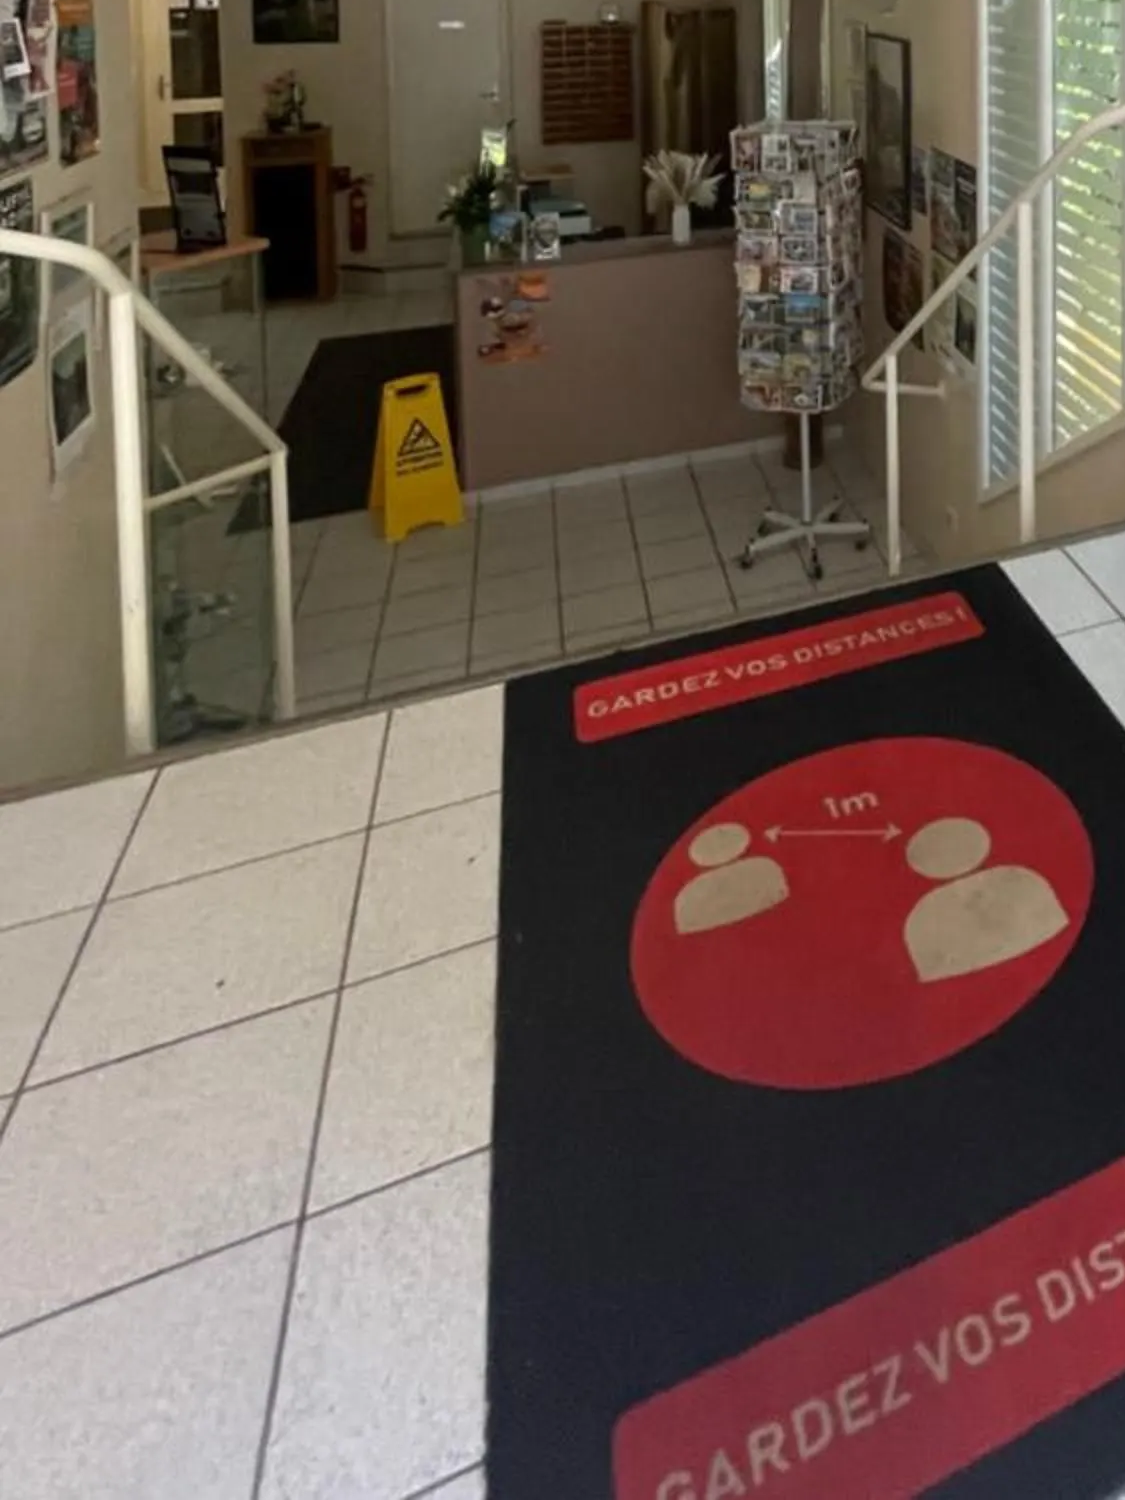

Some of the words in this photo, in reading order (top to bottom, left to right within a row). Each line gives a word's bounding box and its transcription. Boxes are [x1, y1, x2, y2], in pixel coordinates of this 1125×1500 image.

[586, 669, 722, 719] GARDEZ
[724, 652, 788, 682] VOS
[823, 790, 880, 820] 1m
[913, 1292, 1033, 1385] VOS
